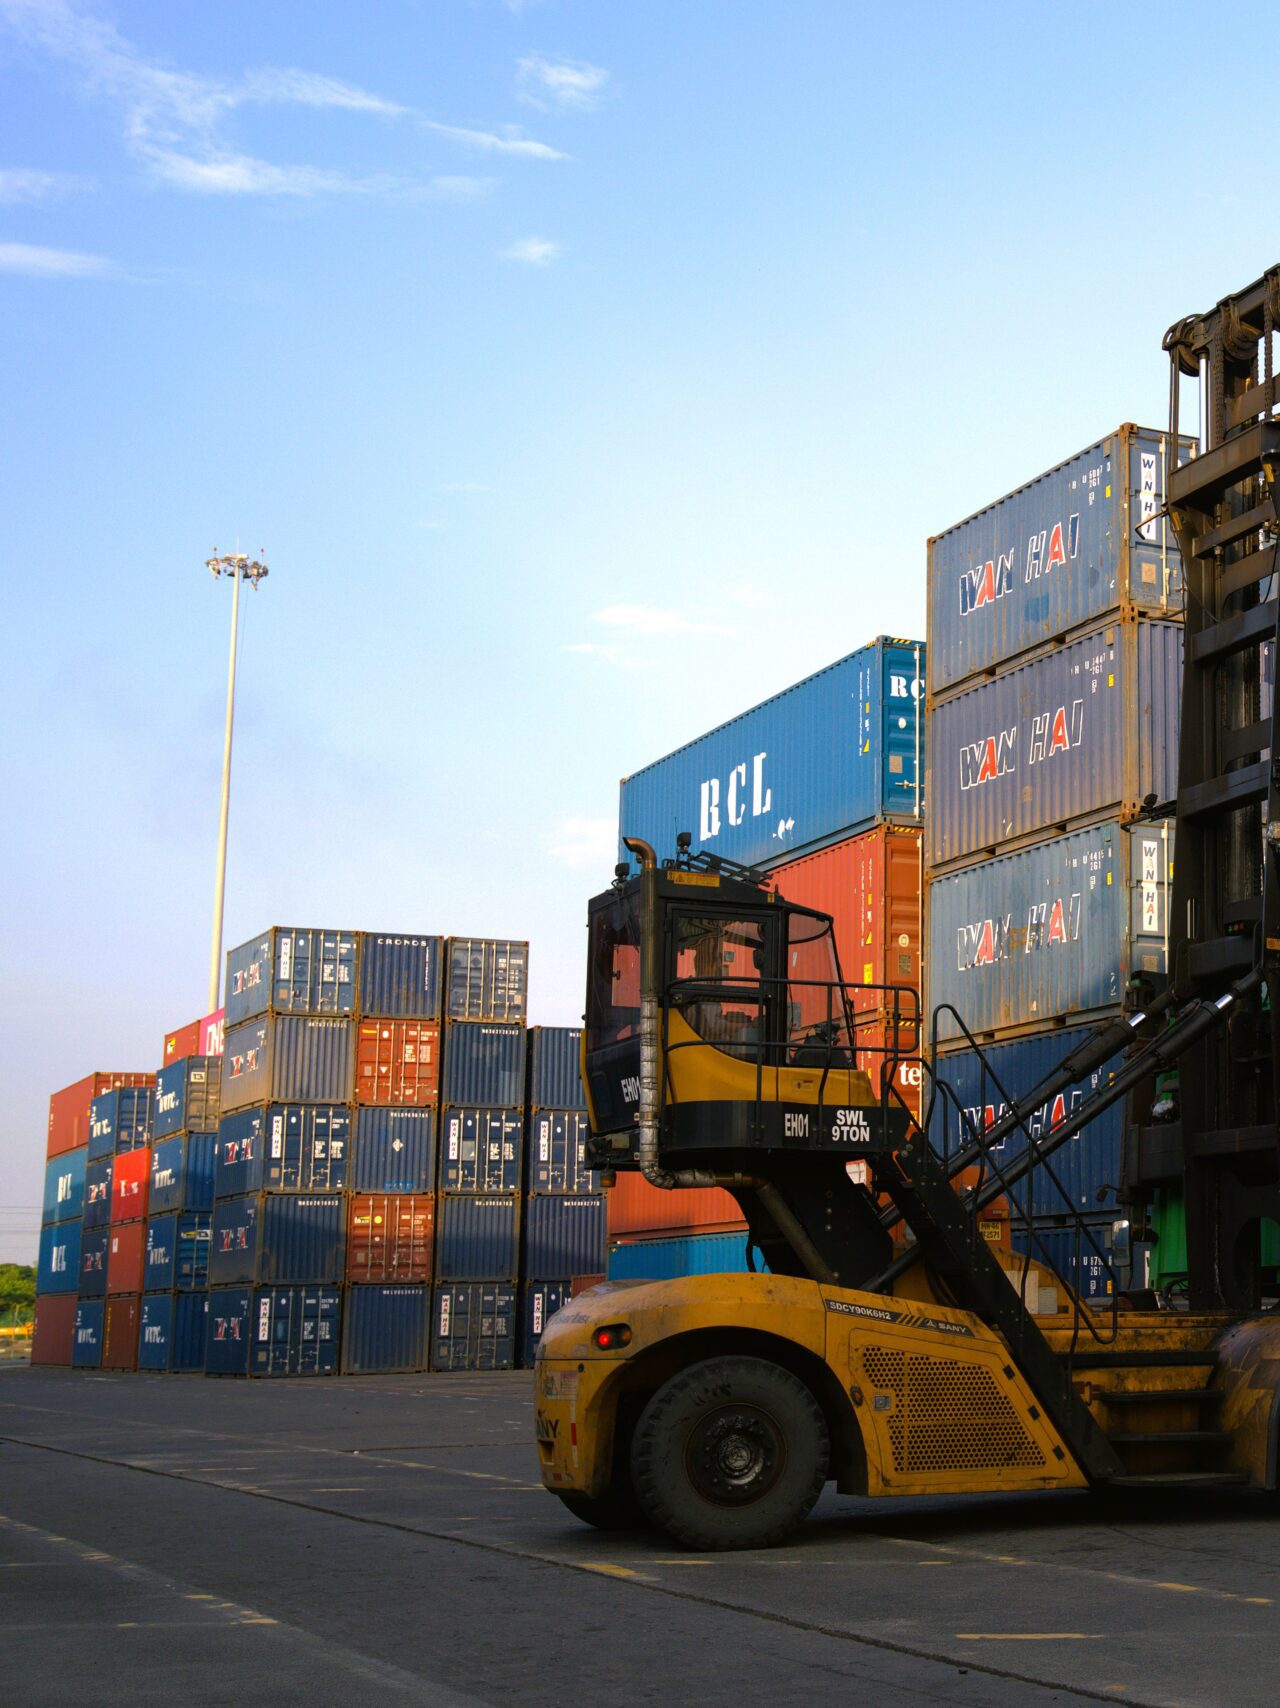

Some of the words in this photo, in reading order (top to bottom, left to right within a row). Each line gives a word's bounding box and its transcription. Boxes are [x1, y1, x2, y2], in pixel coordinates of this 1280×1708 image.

[1142, 458, 1154, 491] WAN
[960, 547, 1015, 616] WAN
[1025, 513, 1079, 584] HAI
[890, 675, 926, 699] RC
[960, 727, 1017, 791] WAN
[1029, 699, 1084, 765] HAI
[700, 752, 771, 841] RCL
[1143, 845, 1156, 880] WAN
[1145, 892, 1155, 926] HAI
[377, 937, 427, 947] CRONOS
[621, 1076, 641, 1103] EH01
[784, 1113, 809, 1138] EH01
[836, 1109, 868, 1127] SWL
[829, 1300, 892, 1321] SDCY90K6H2
[938, 1322, 967, 1335] SANY
[537, 1419, 560, 1439] ANY
